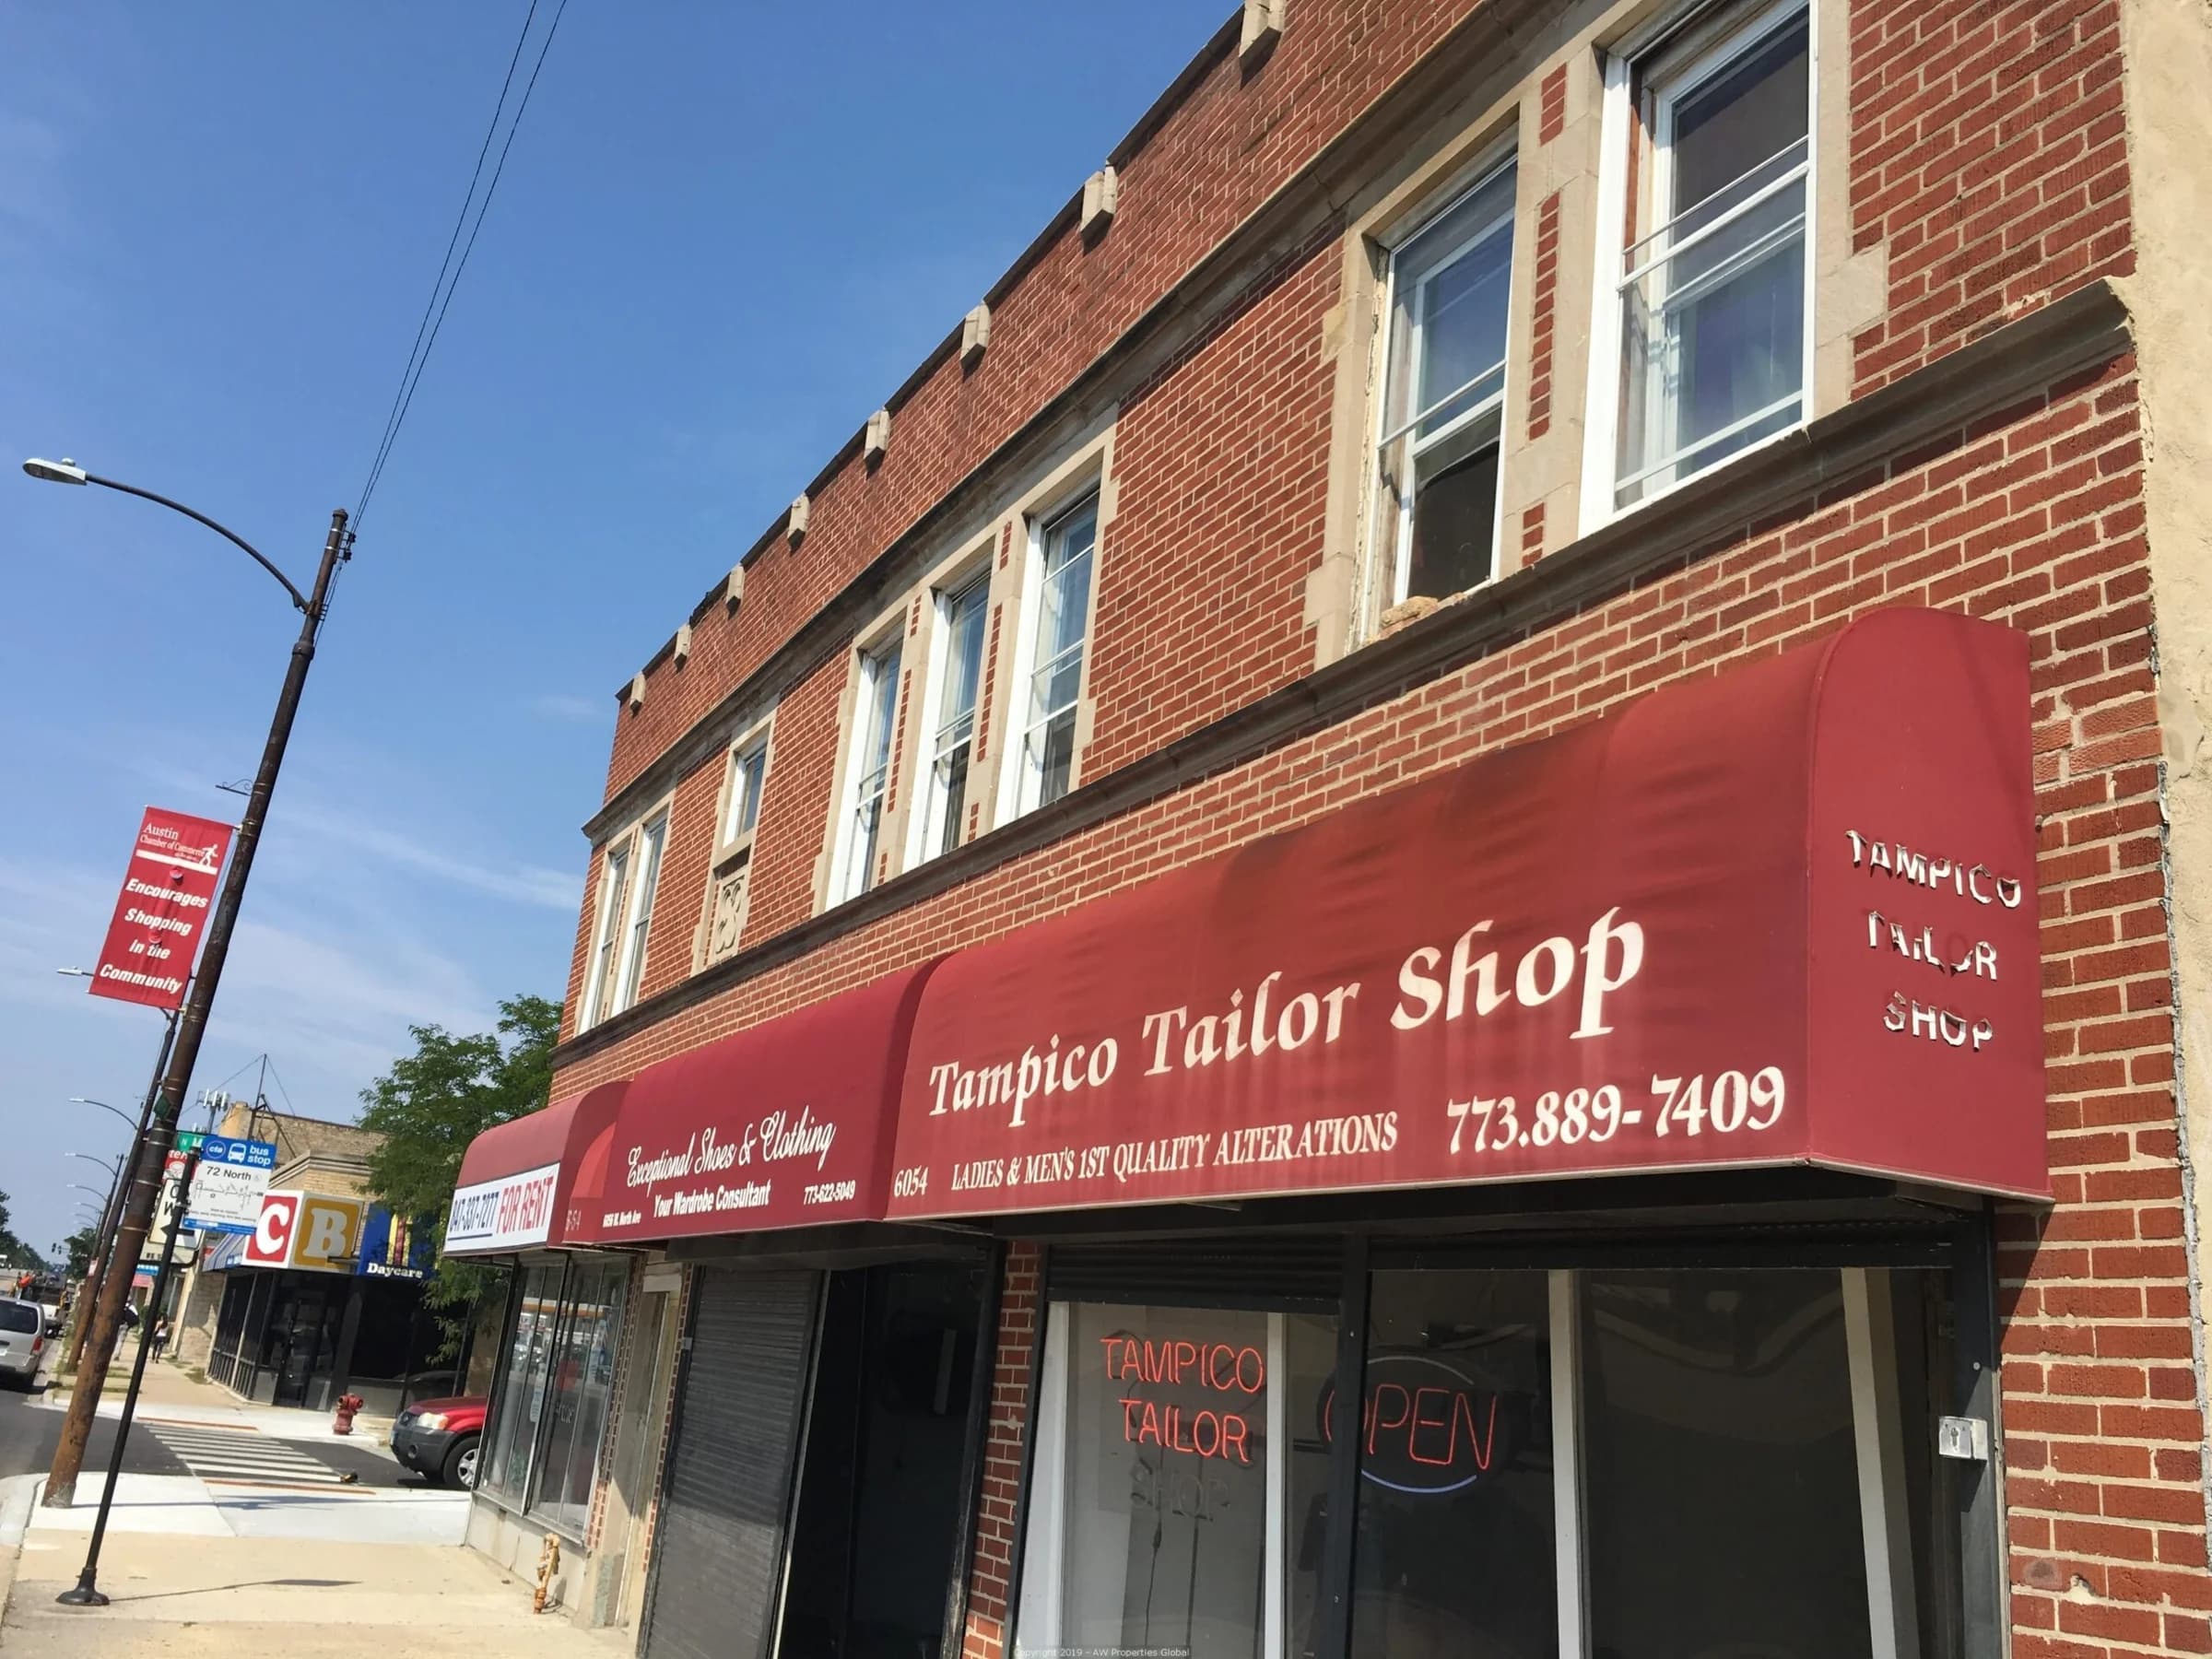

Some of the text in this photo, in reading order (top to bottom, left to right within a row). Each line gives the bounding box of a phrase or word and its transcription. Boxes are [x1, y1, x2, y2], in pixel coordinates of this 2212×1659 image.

[140, 834, 166, 848] Chamber
[167, 841, 175, 850] of
[143, 823, 179, 840] Austin
[125, 878, 208, 908] Encourages
[124, 908, 193, 936] Shopping
[129, 939, 144, 954] in
[100, 963, 182, 994] Community
[928, 907, 1644, 1127] Tampico Tailor Shop
[1883, 991, 1994, 1051] SHOP
[247, 1154, 271, 1167] stop
[249, 1145, 269, 1156] bus
[627, 1104, 837, 1198] Exceptional Shoes & Clothing
[894, 1165, 928, 1198] 6054
[951, 1158, 1004, 1191] LADIES
[1006, 1157, 1022, 1186] &
[1025, 1147, 1076, 1183] MEN'S
[1077, 1146, 1111, 1179] 1ST
[1112, 1132, 1211, 1183] QUALITY
[1212, 1111, 1398, 1166] ALTERATIONS
[206, 1166, 252, 1181] 72 North
[496, 1184, 523, 1234] FOR
[518, 1175, 554, 1232] RENT
[653, 1194, 674, 1218] Your
[673, 1186, 714, 1215] Wardrobe
[715, 1178, 772, 1211] Consultant
[254, 1203, 290, 1255] C
[303, 1206, 348, 1257] B
[367, 1262, 424, 1279] Daycare
[1100, 1337, 1265, 1393] TAMPICO
[1118, 1398, 1250, 1463] TAILOR
